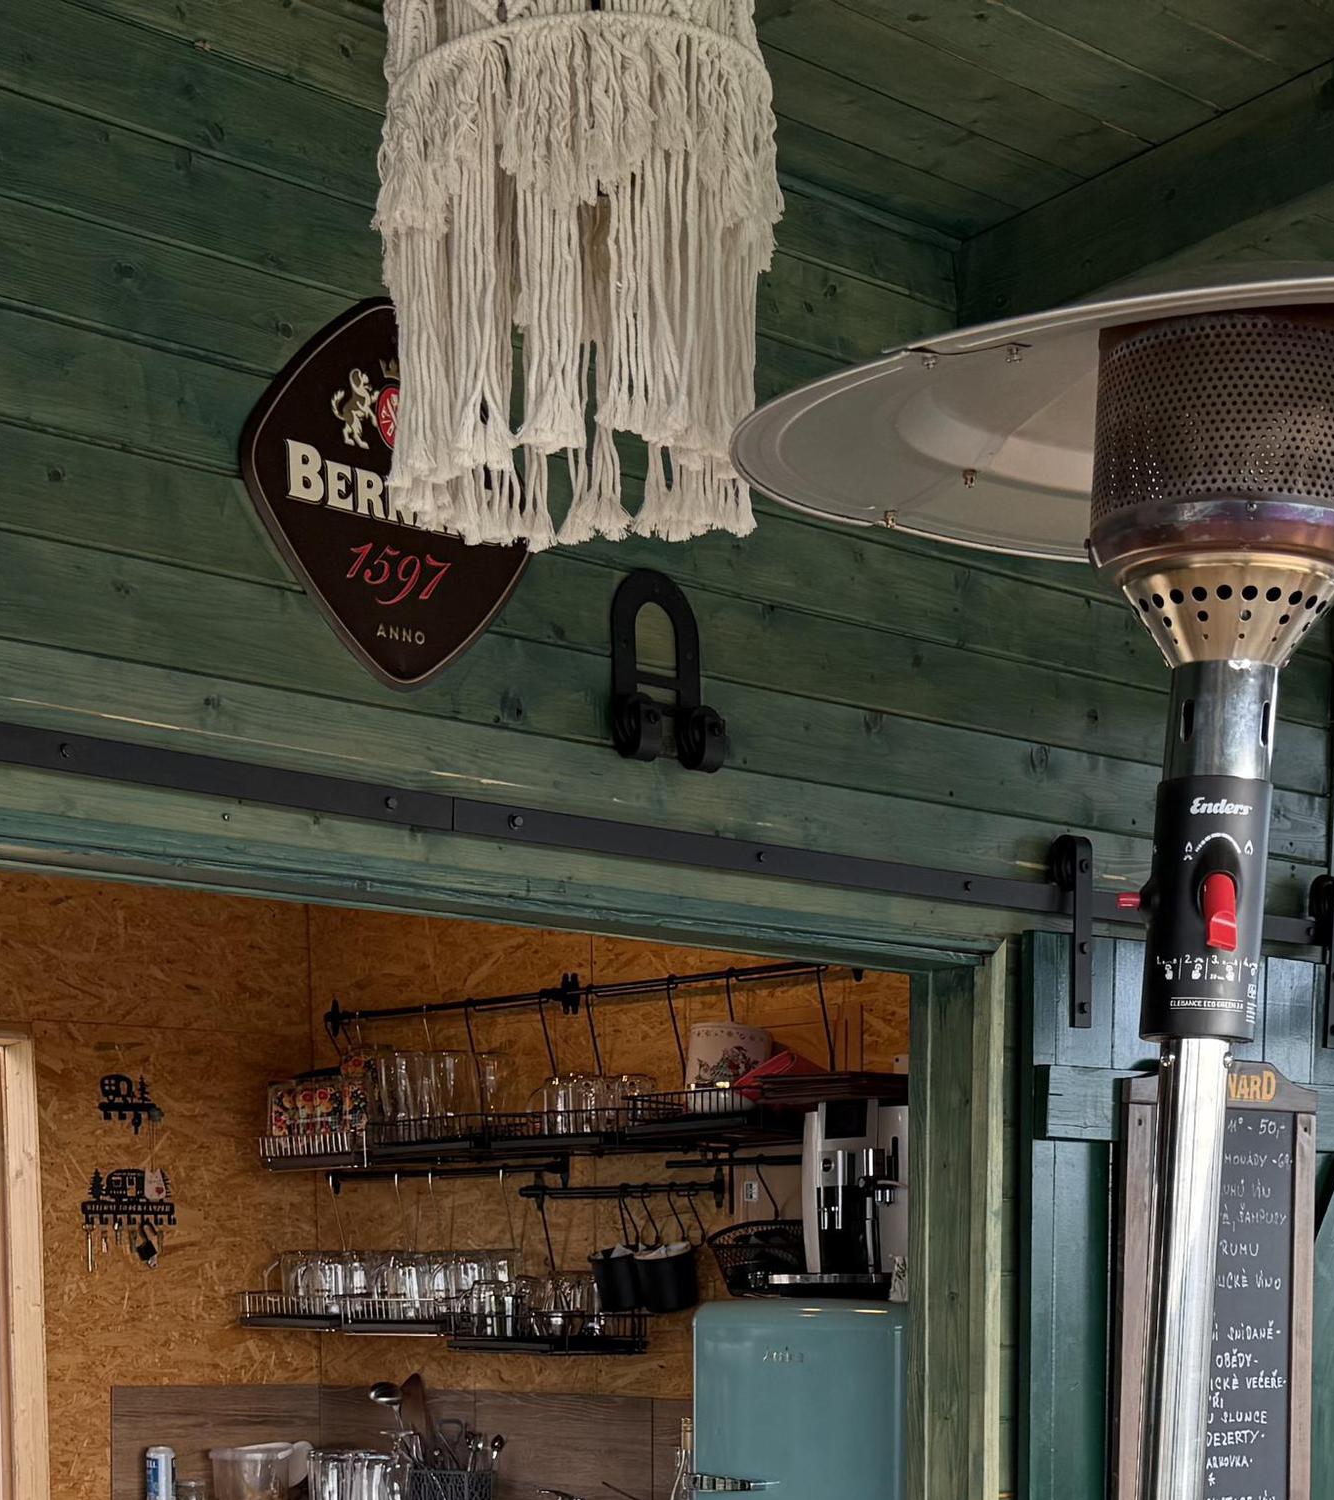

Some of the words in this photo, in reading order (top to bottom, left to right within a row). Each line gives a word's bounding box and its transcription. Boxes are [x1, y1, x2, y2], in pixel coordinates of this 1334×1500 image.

[347, 542, 452, 605] 1597
[376, 623, 426, 645] ANNO
[1189, 796, 1254, 816] Enders
[1219, 1239, 1259, 1256] RUMU
[1221, 1410, 1268, 1424] SLUNCE
